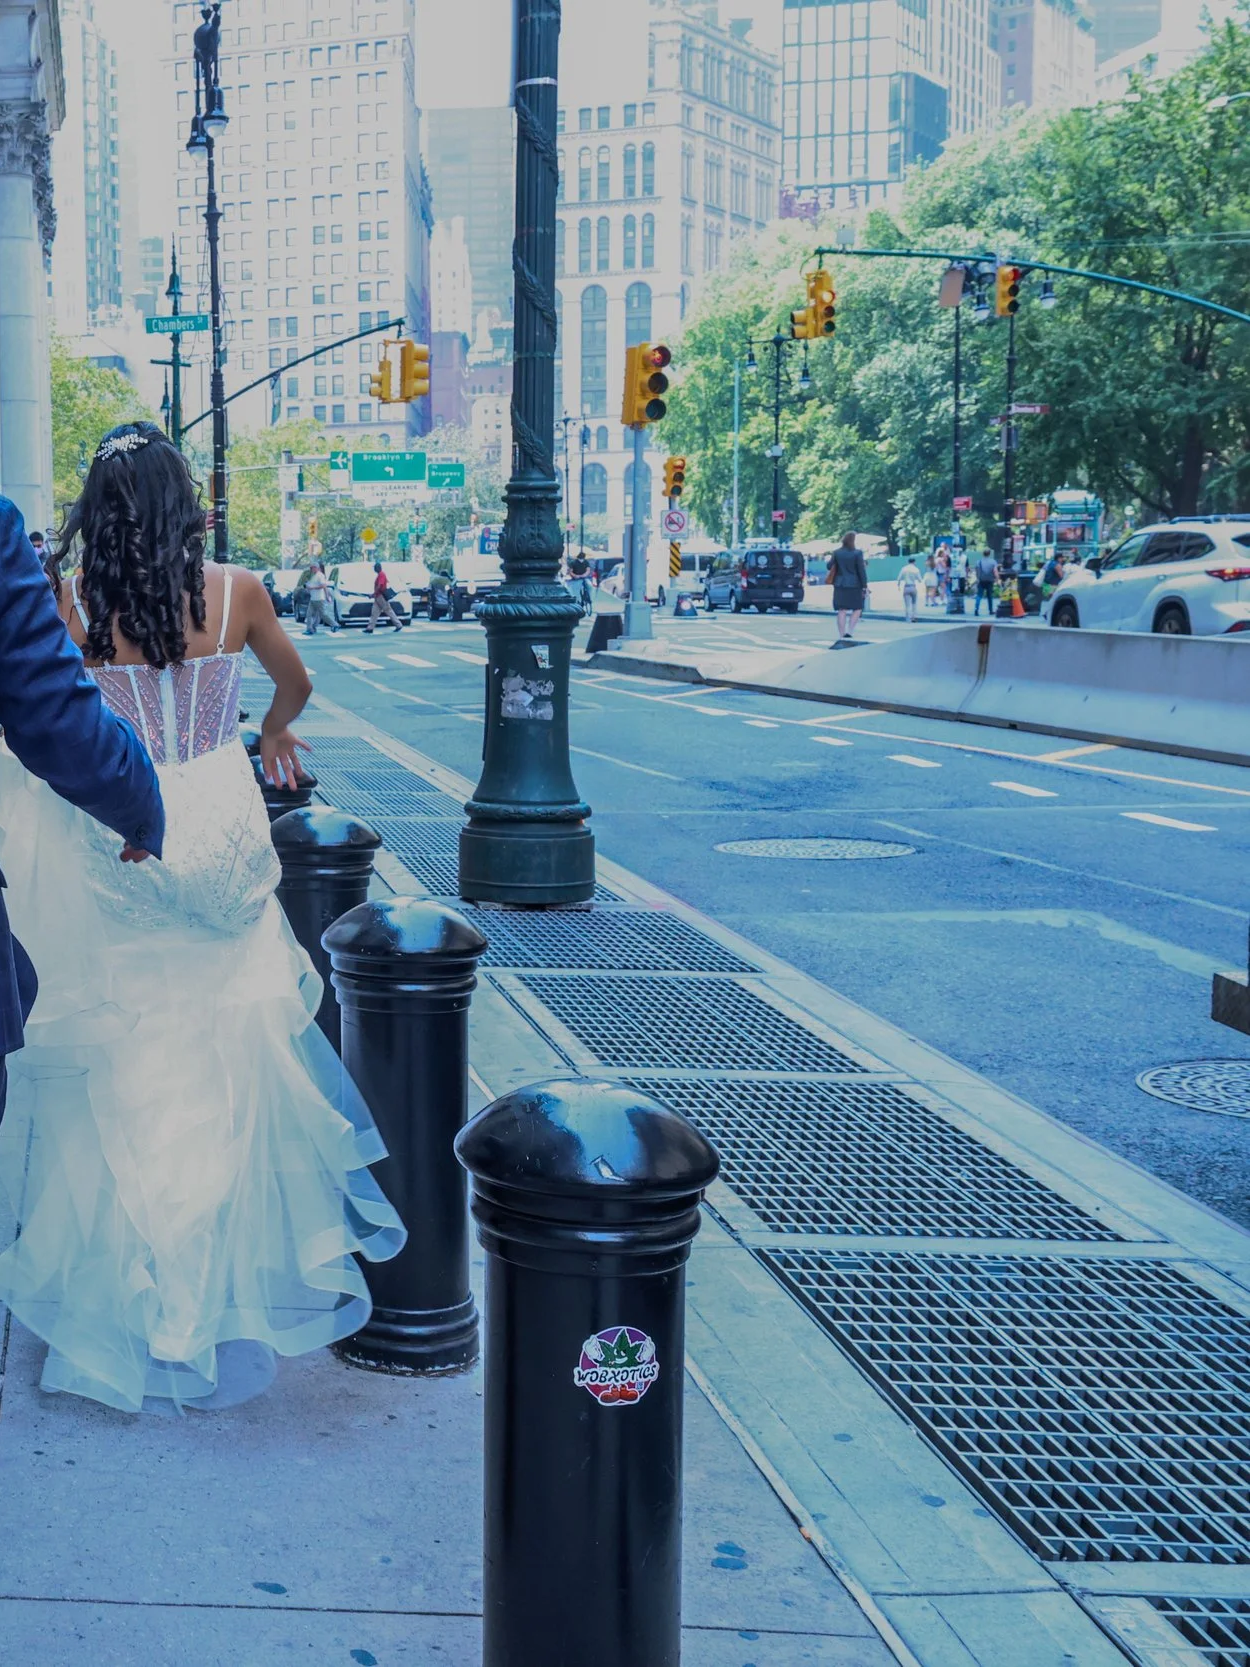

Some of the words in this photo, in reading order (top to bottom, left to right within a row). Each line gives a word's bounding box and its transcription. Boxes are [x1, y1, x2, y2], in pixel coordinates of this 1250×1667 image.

[152, 318, 195, 331] Chambers
[363, 453, 400, 461] Brooklyn
[577, 1364, 657, 1383] WOBXOTICS
